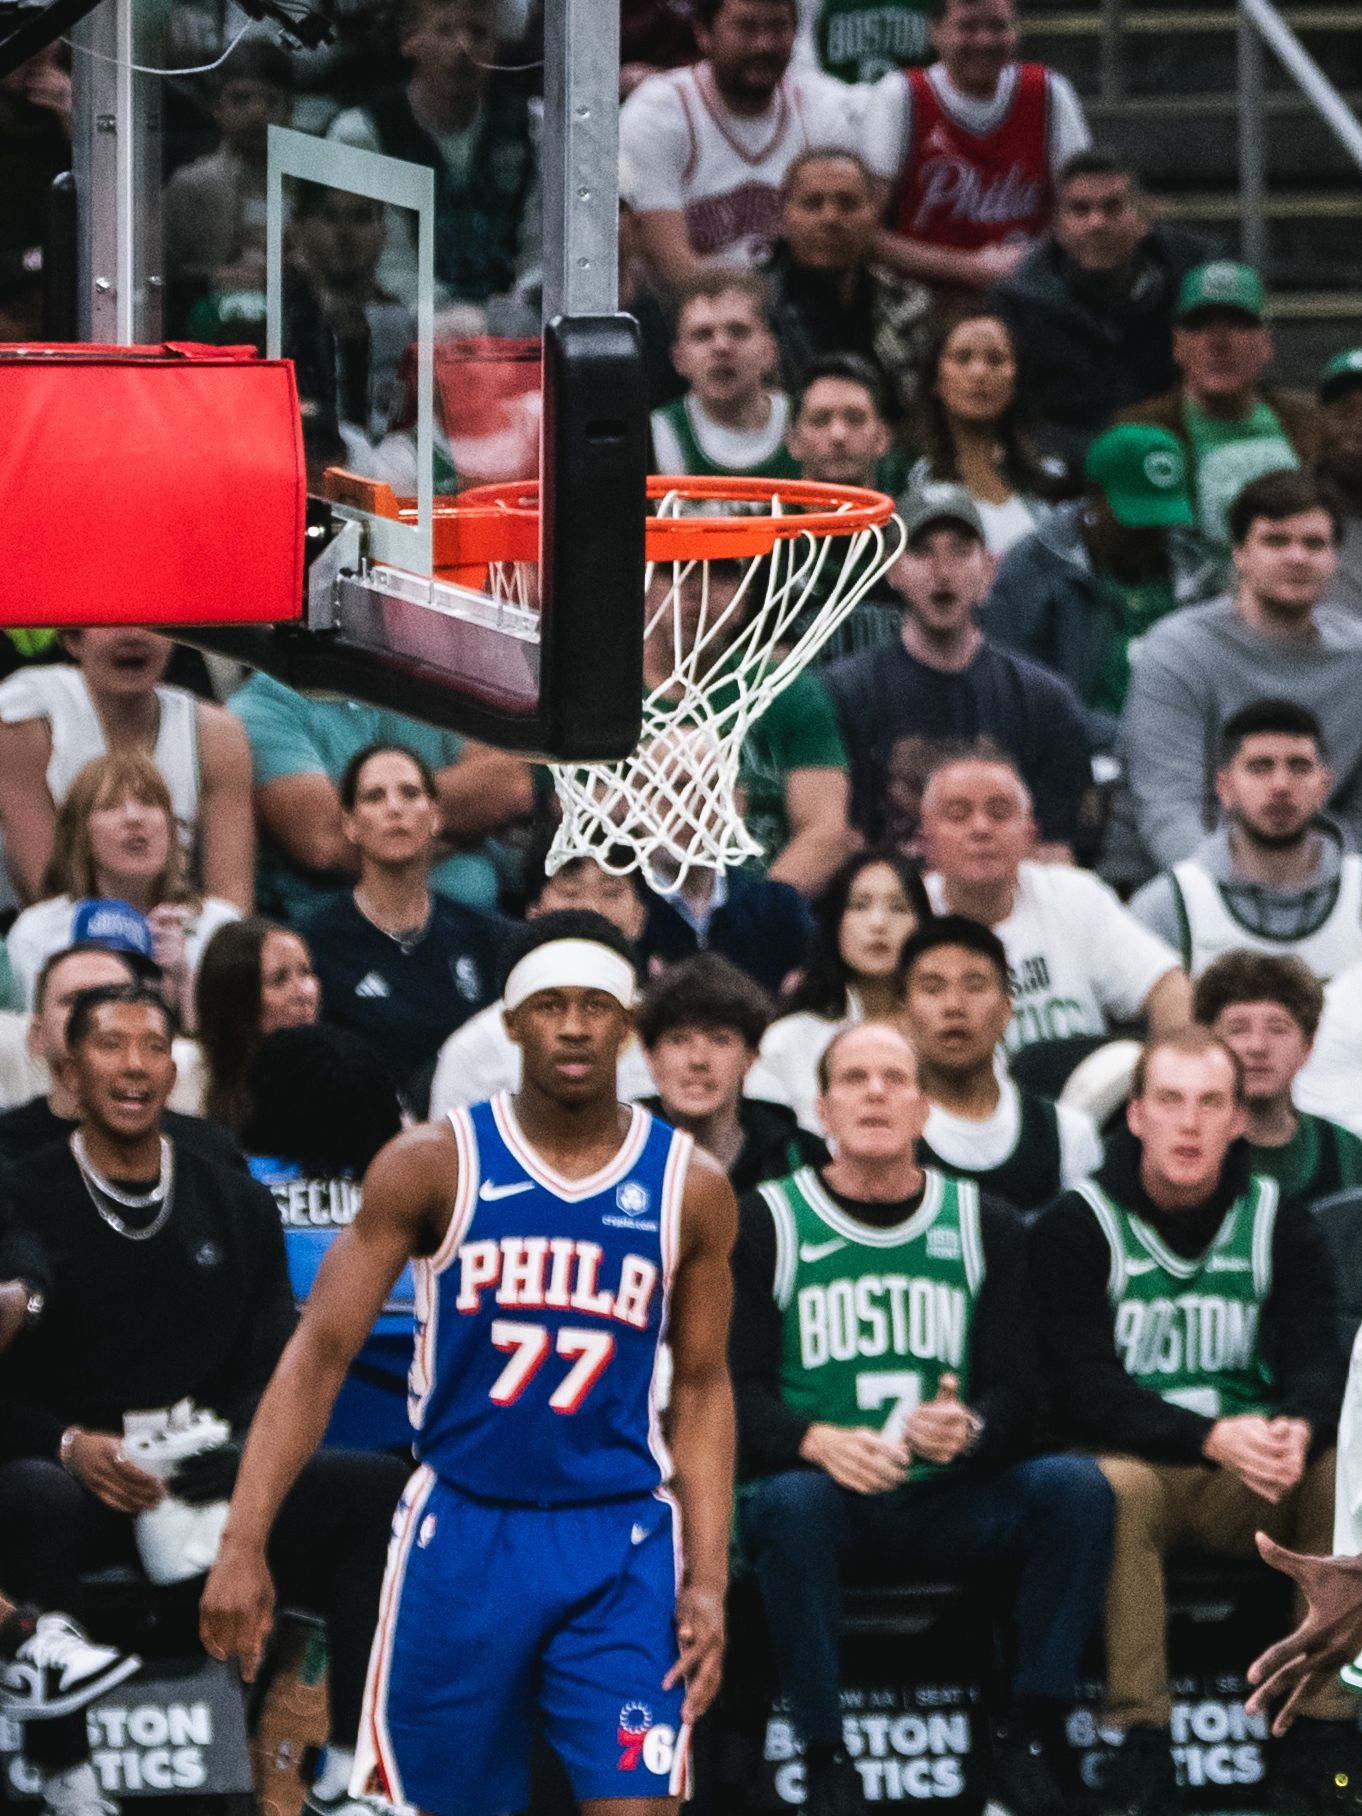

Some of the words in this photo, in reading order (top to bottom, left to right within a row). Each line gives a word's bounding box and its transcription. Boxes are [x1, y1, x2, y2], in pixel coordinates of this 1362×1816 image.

[270, 1180, 364, 1226] SECU
[456, 1236, 659, 1330] PHILA
[797, 1273, 969, 1370] BOSTON
[489, 1319, 617, 1415] 77
[856, 1372, 921, 1444] 7
[617, 1723, 675, 1776] 76
[763, 1710, 971, 1762] BSTON
[774, 1755, 966, 1805] CTICS
